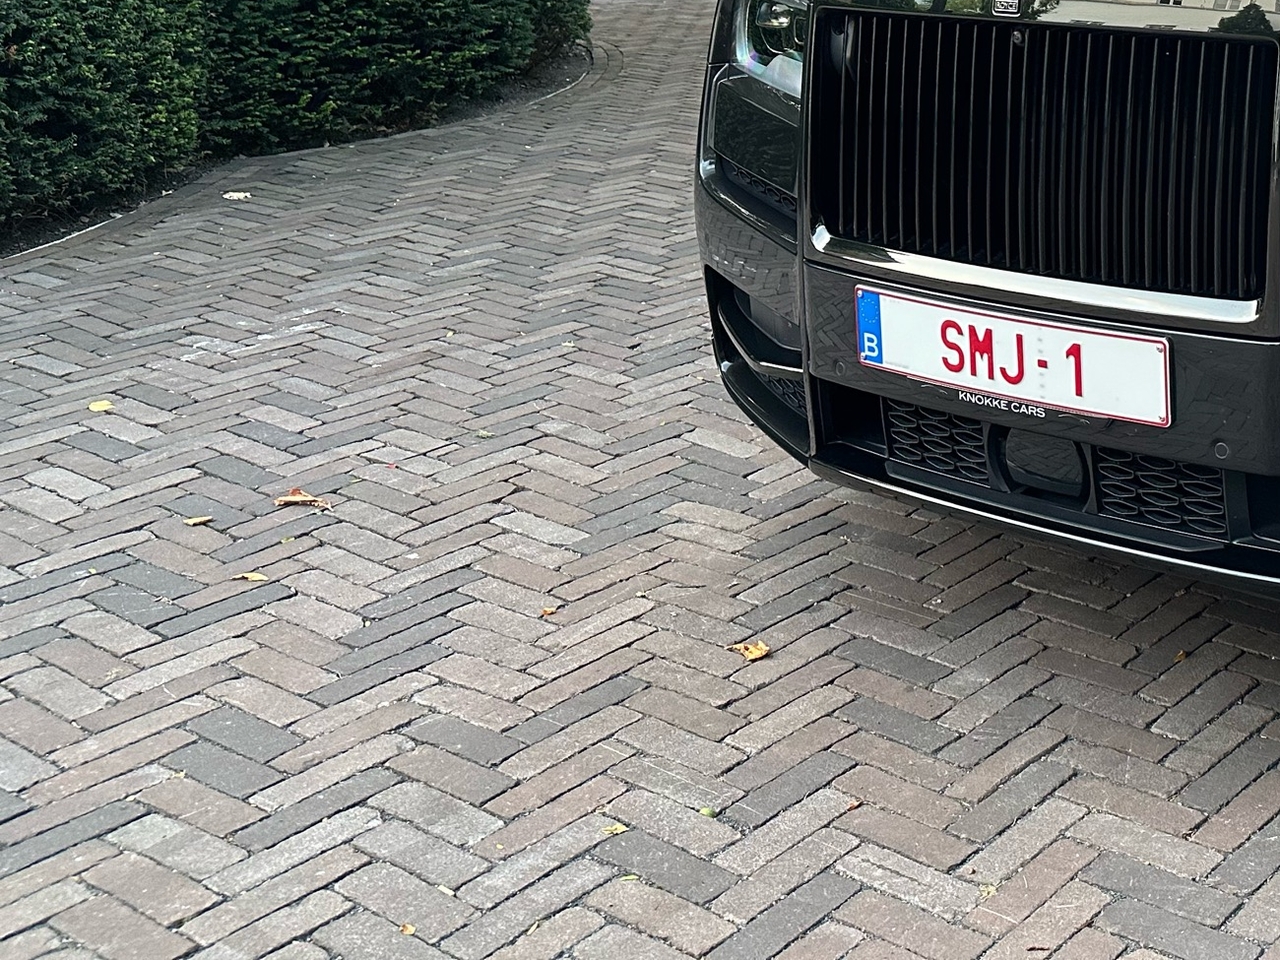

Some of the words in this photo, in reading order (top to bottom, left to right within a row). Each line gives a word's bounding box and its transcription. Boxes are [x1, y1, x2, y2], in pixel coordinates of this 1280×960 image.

[863, 332, 879, 358] B
[940, 319, 1083, 398] SMJ-1
[958, 391, 1009, 411] KNOKKE
[1011, 402, 1046, 418] CARS
